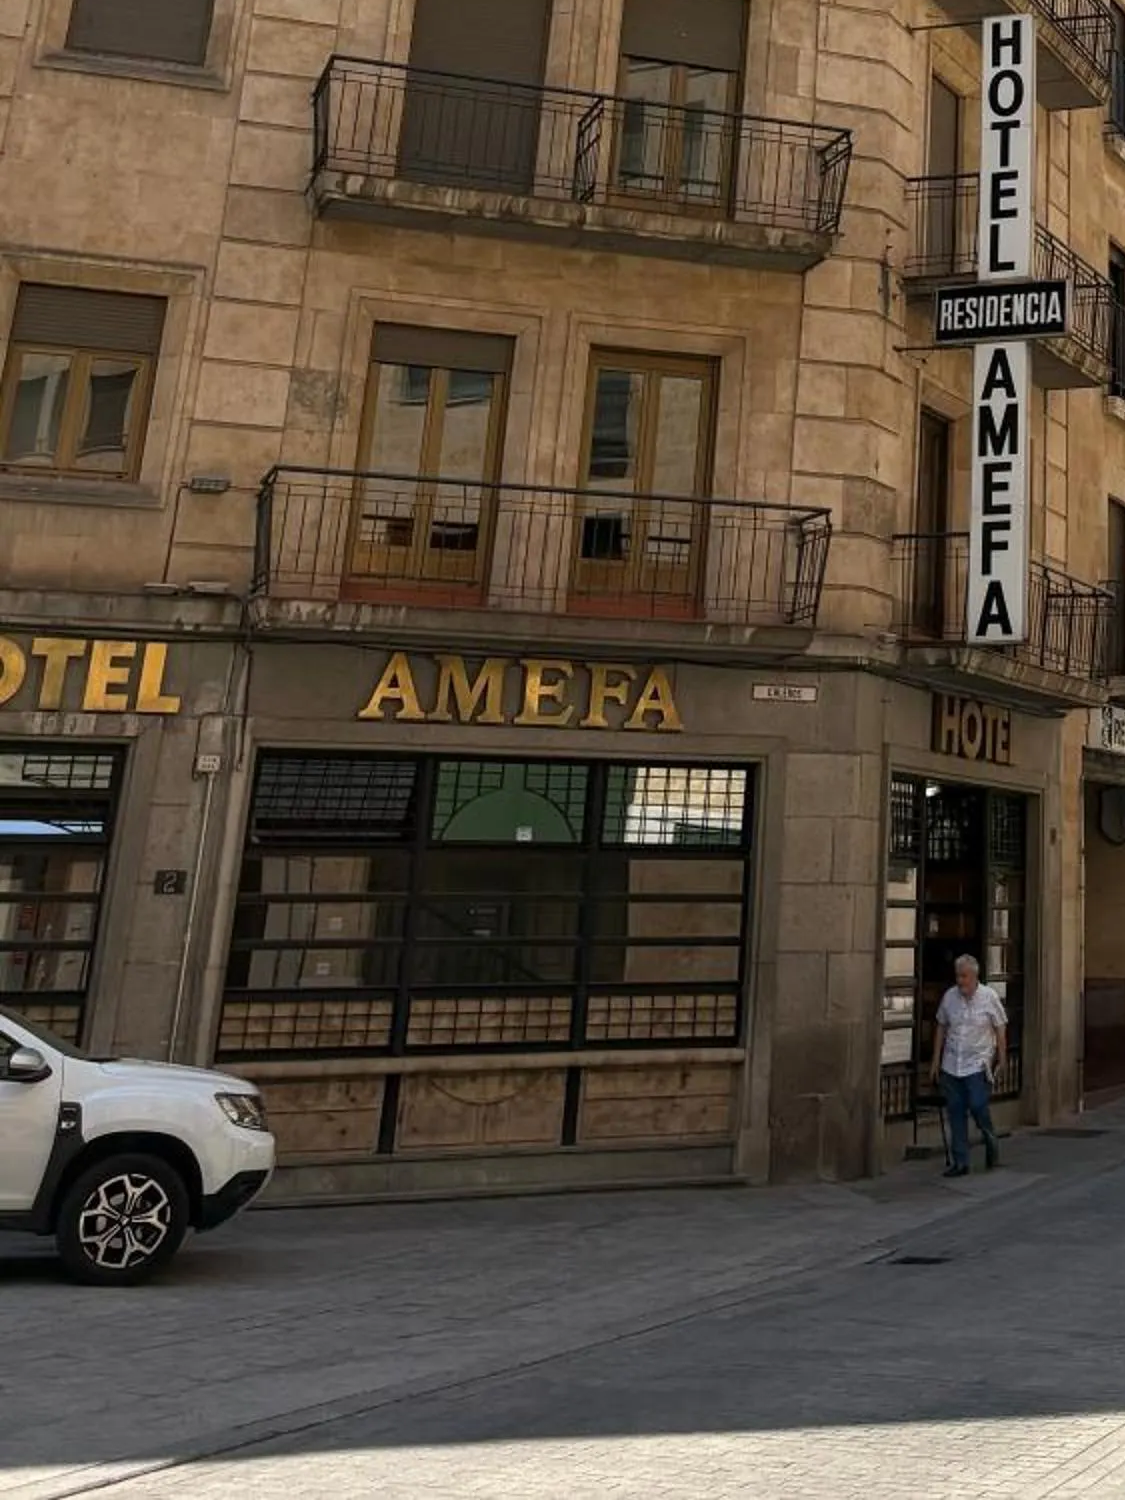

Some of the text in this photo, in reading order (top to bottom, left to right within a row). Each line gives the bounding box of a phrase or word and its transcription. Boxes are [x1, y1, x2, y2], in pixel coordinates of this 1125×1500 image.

[988, 19, 1024, 273] HOTEL
[940, 291, 1063, 331] RESIDENCIA
[976, 348, 1019, 637] AMEFA
[357, 651, 685, 732] AMEFA
